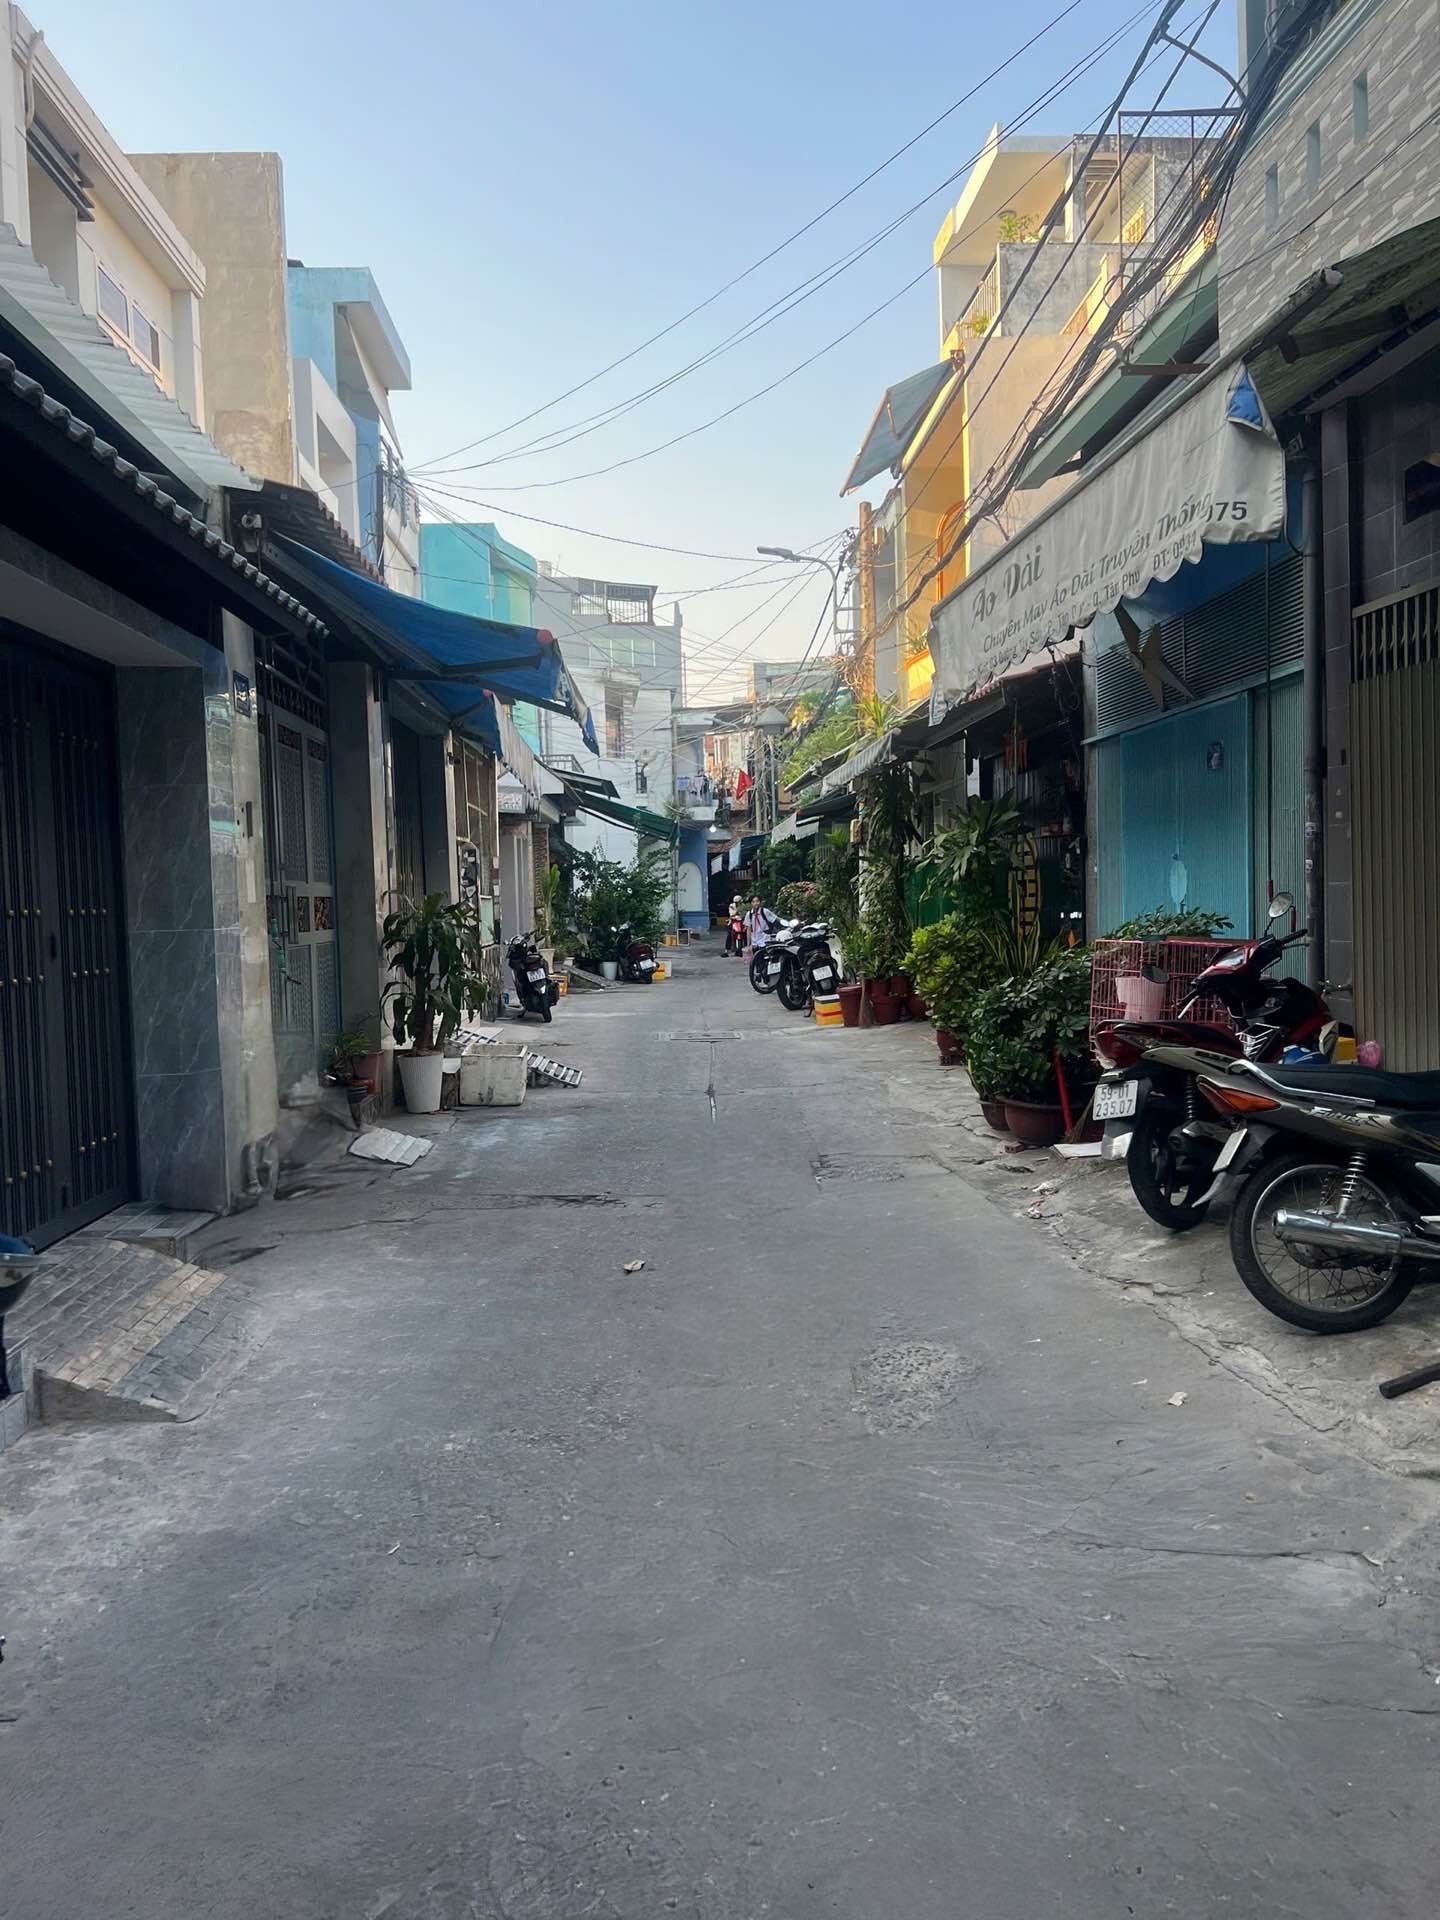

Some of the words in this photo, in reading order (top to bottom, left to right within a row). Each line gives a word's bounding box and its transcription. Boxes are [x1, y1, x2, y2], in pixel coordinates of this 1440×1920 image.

[1003, 544, 1045, 599] Dài
[983, 619, 1020, 654] Chuyên
[1022, 599, 1048, 628] May
[1049, 581, 1068, 611] Áo
[1070, 563, 1095, 597] Dài
[1096, 1099, 1133, 1118] 235.07
